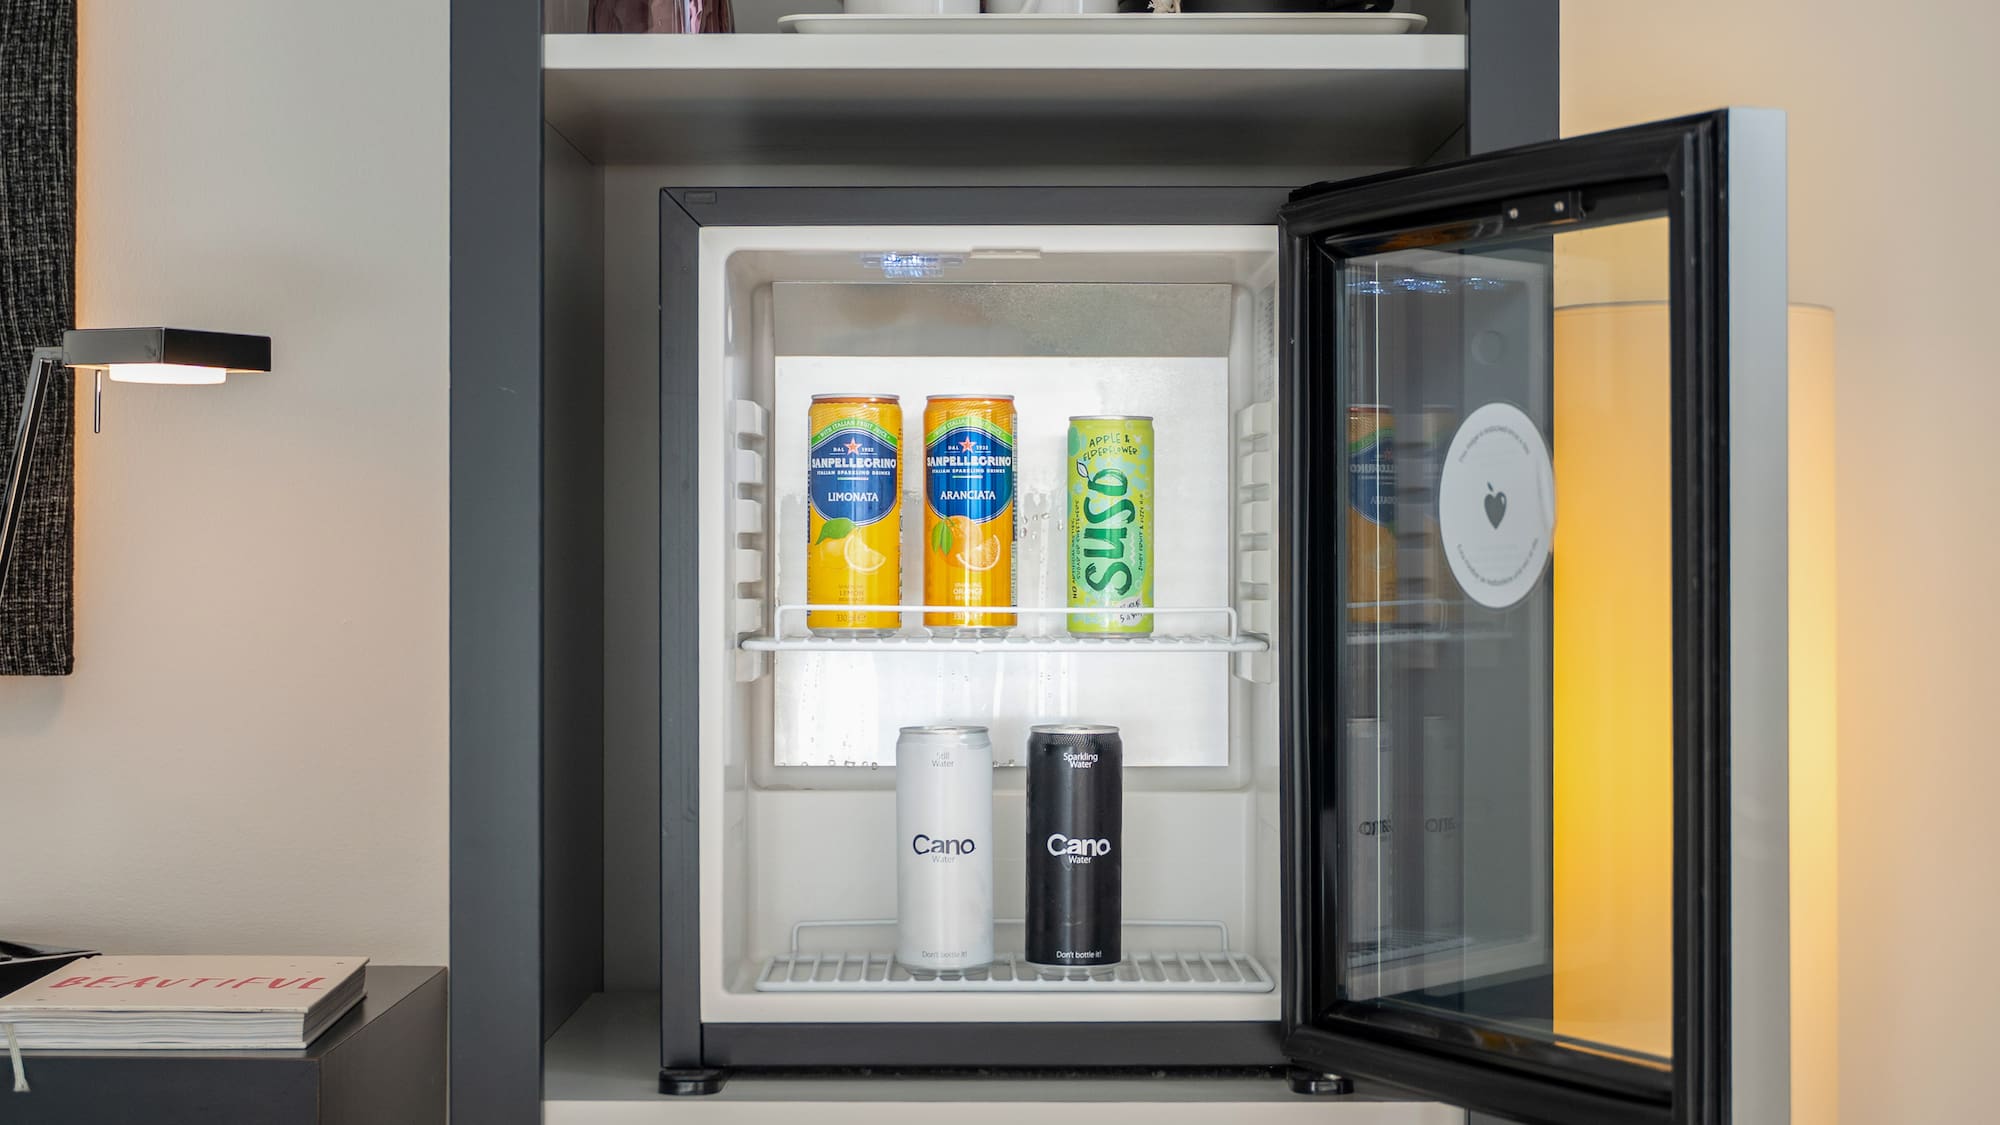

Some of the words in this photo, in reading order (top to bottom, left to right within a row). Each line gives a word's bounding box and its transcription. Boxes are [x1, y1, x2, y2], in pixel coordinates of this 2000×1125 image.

[1089, 432, 1121, 448] APPLE
[812, 457, 897, 469] SANPELLEGRINO
[926, 455, 1012, 467] SANPELLEGRINO
[828, 492, 879, 502] LIMONATA
[940, 490, 996, 500] ARANCIATA
[1072, 585, 1078, 599] NO
[1063, 752, 1099, 763] Sparkling
[931, 760, 955, 768] Water
[1069, 760, 1093, 768] Water
[912, 833, 976, 856] Cano
[1047, 833, 1111, 857] Cano
[932, 855, 956, 864] Water
[1069, 855, 1092, 864] Water
[1056, 950, 1074, 959] Don't
[1075, 950, 1094, 959] bottle
[48, 976, 328, 990] BEAUTIFUL
